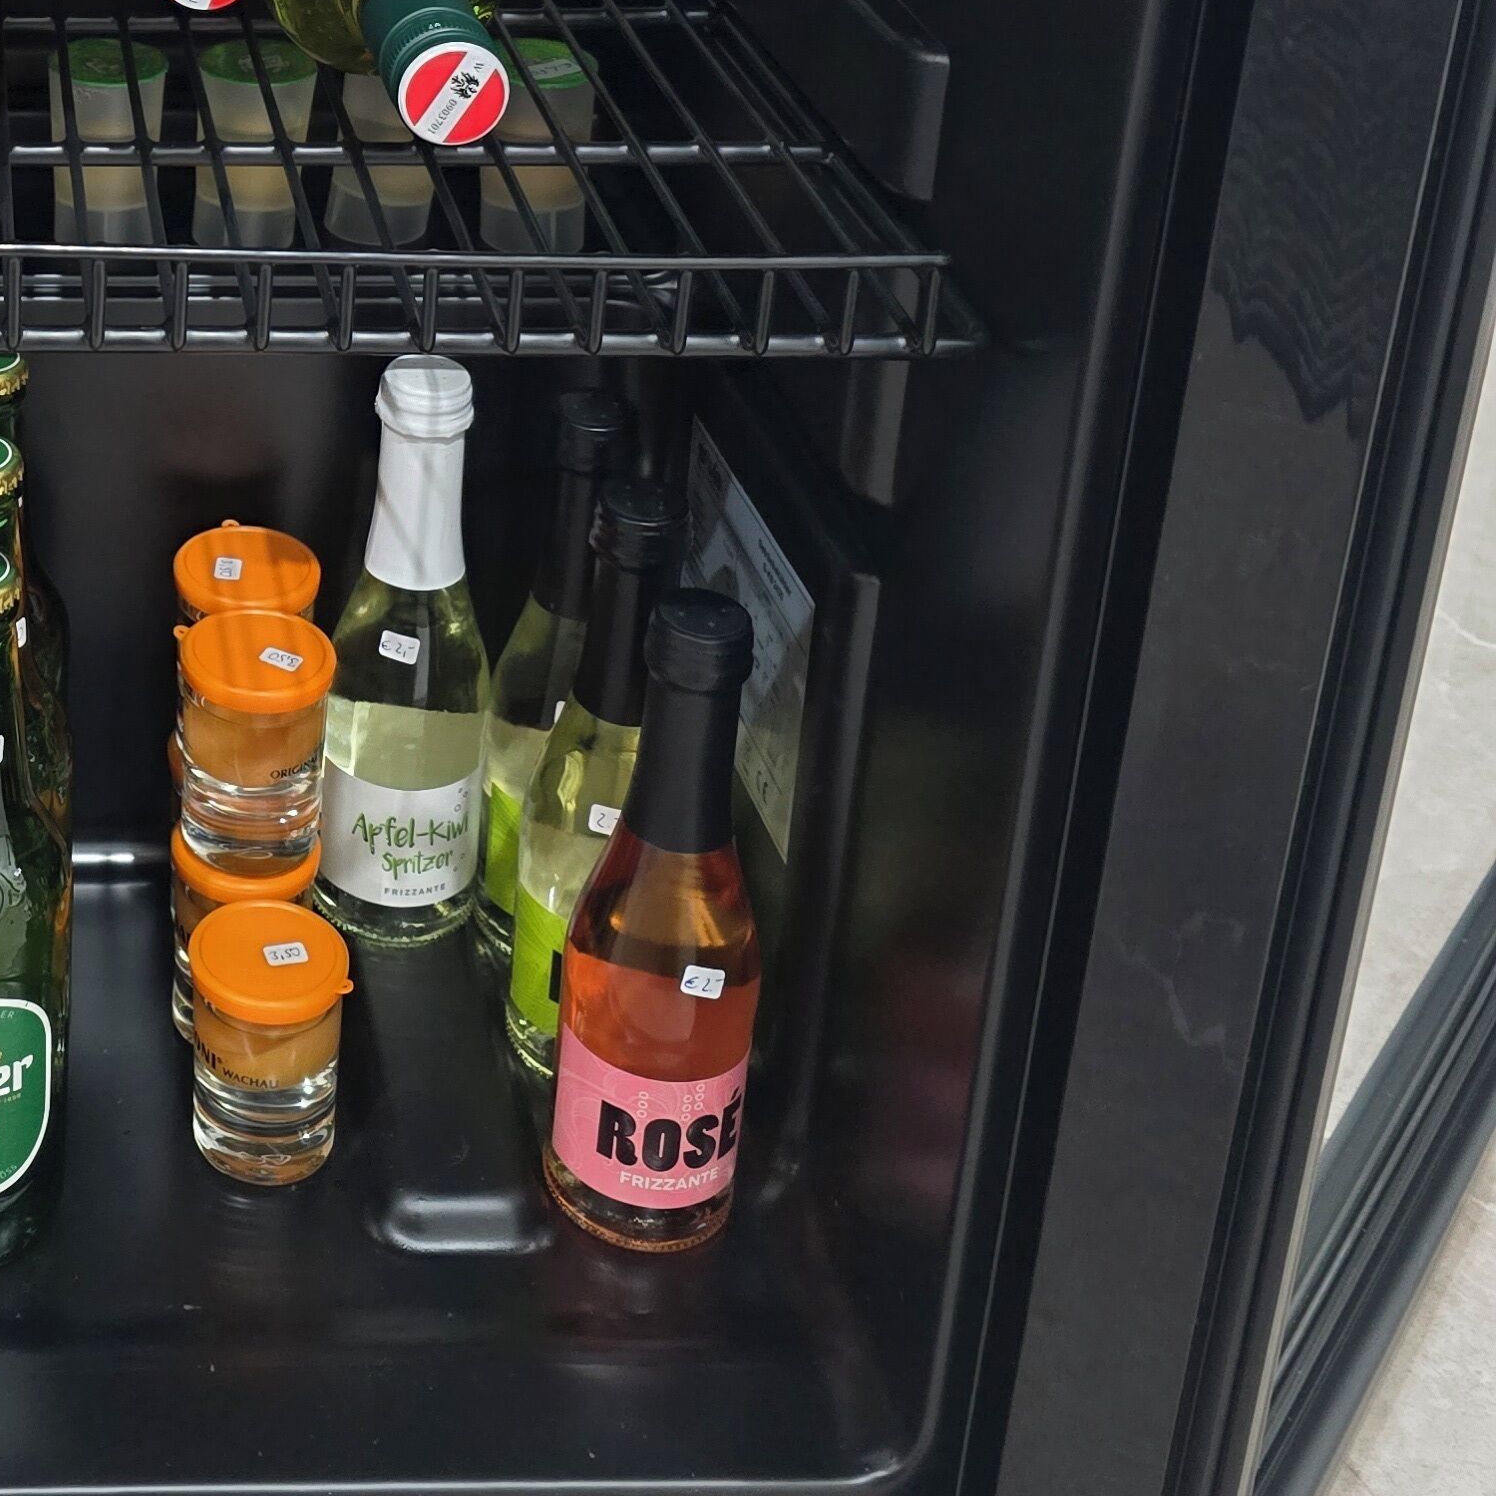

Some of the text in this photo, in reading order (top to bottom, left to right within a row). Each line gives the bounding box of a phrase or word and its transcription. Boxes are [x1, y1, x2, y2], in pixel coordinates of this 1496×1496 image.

[351, 810, 469, 855] Apfel-Kiwi
[383, 882, 447, 897] FRIZZANTE
[269, 945, 302, 962] 3,50
[683, 975, 700, 990] €
[222, 1066, 281, 1089] WACHAU
[596, 1087, 744, 1173] ROSÉ
[619, 1166, 721, 1192] FRIZZANTE
